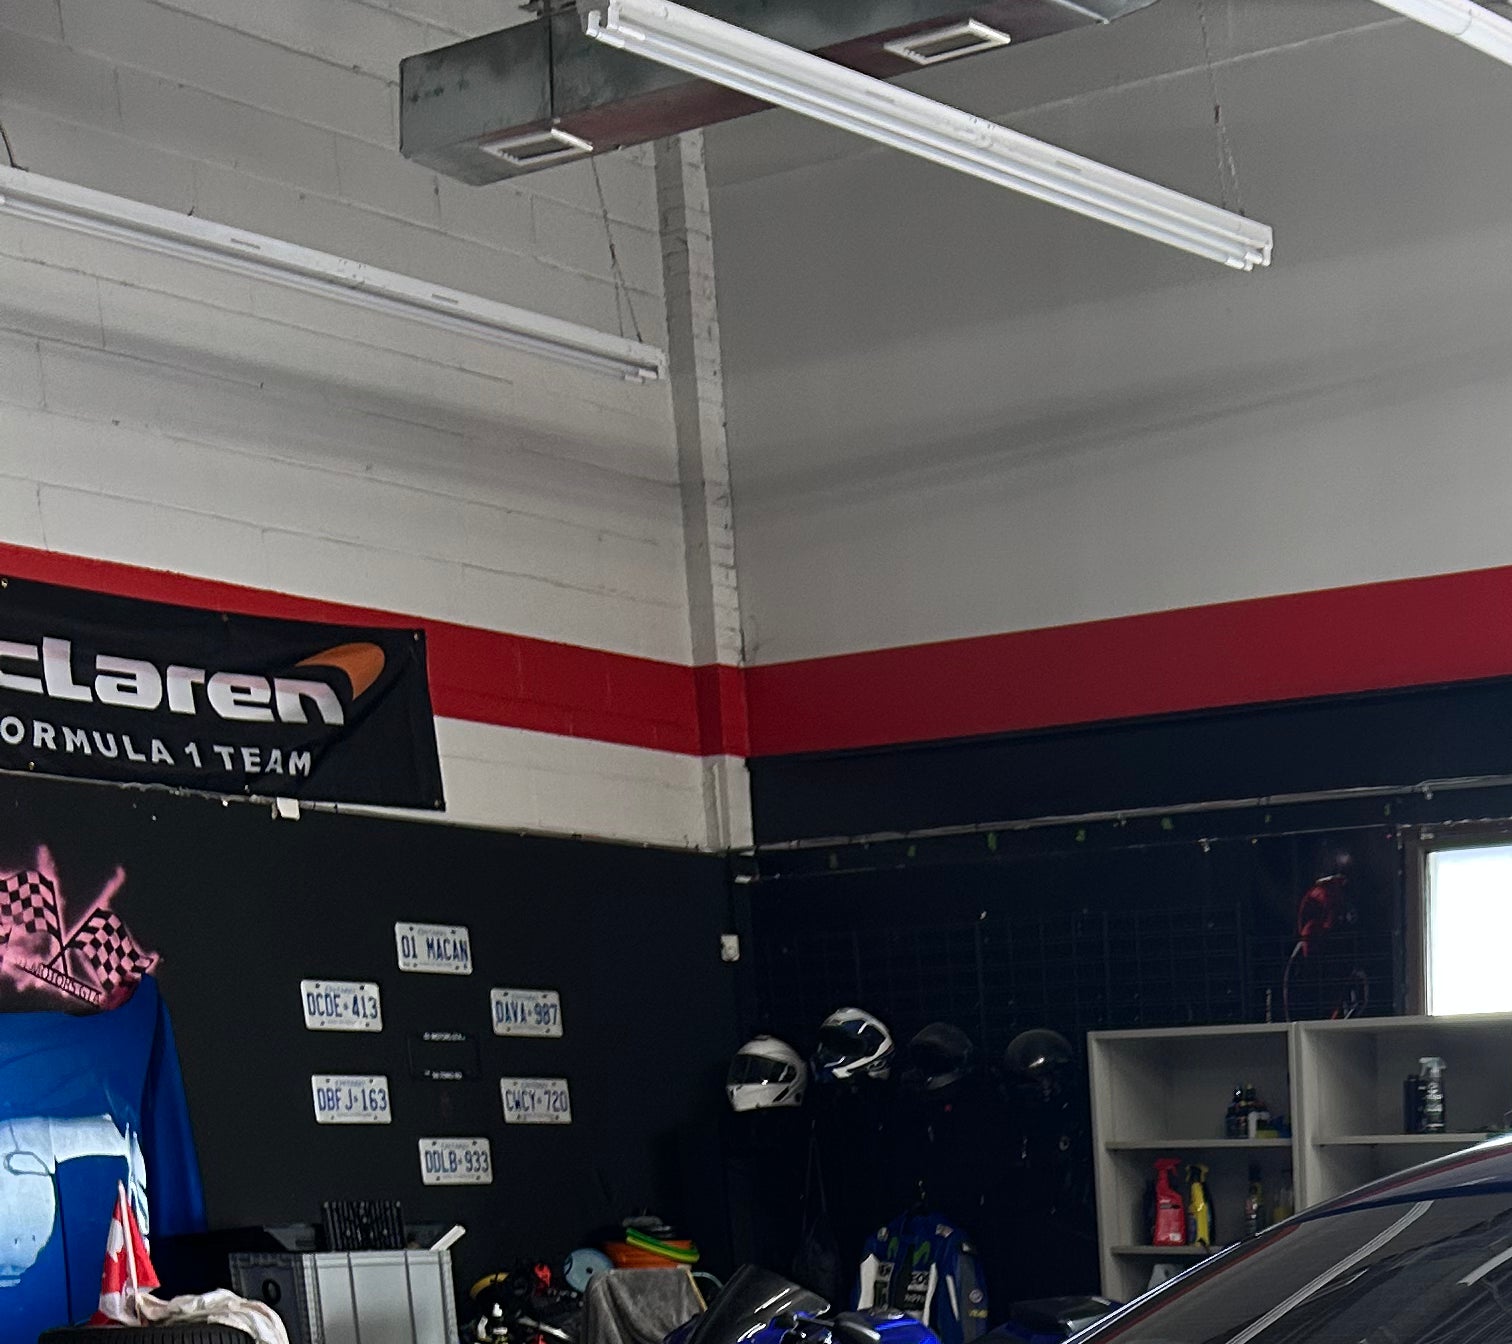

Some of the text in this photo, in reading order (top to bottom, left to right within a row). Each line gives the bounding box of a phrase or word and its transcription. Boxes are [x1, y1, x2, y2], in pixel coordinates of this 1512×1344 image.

[184, 741, 203, 769] 1
[213, 744, 312, 778] TEAM
[425, 936, 469, 962] MACAN
[352, 993, 379, 1020] 413
[361, 1087, 388, 1112] 163
[543, 1089, 568, 1113] 720
[464, 1149, 489, 1174] 933
